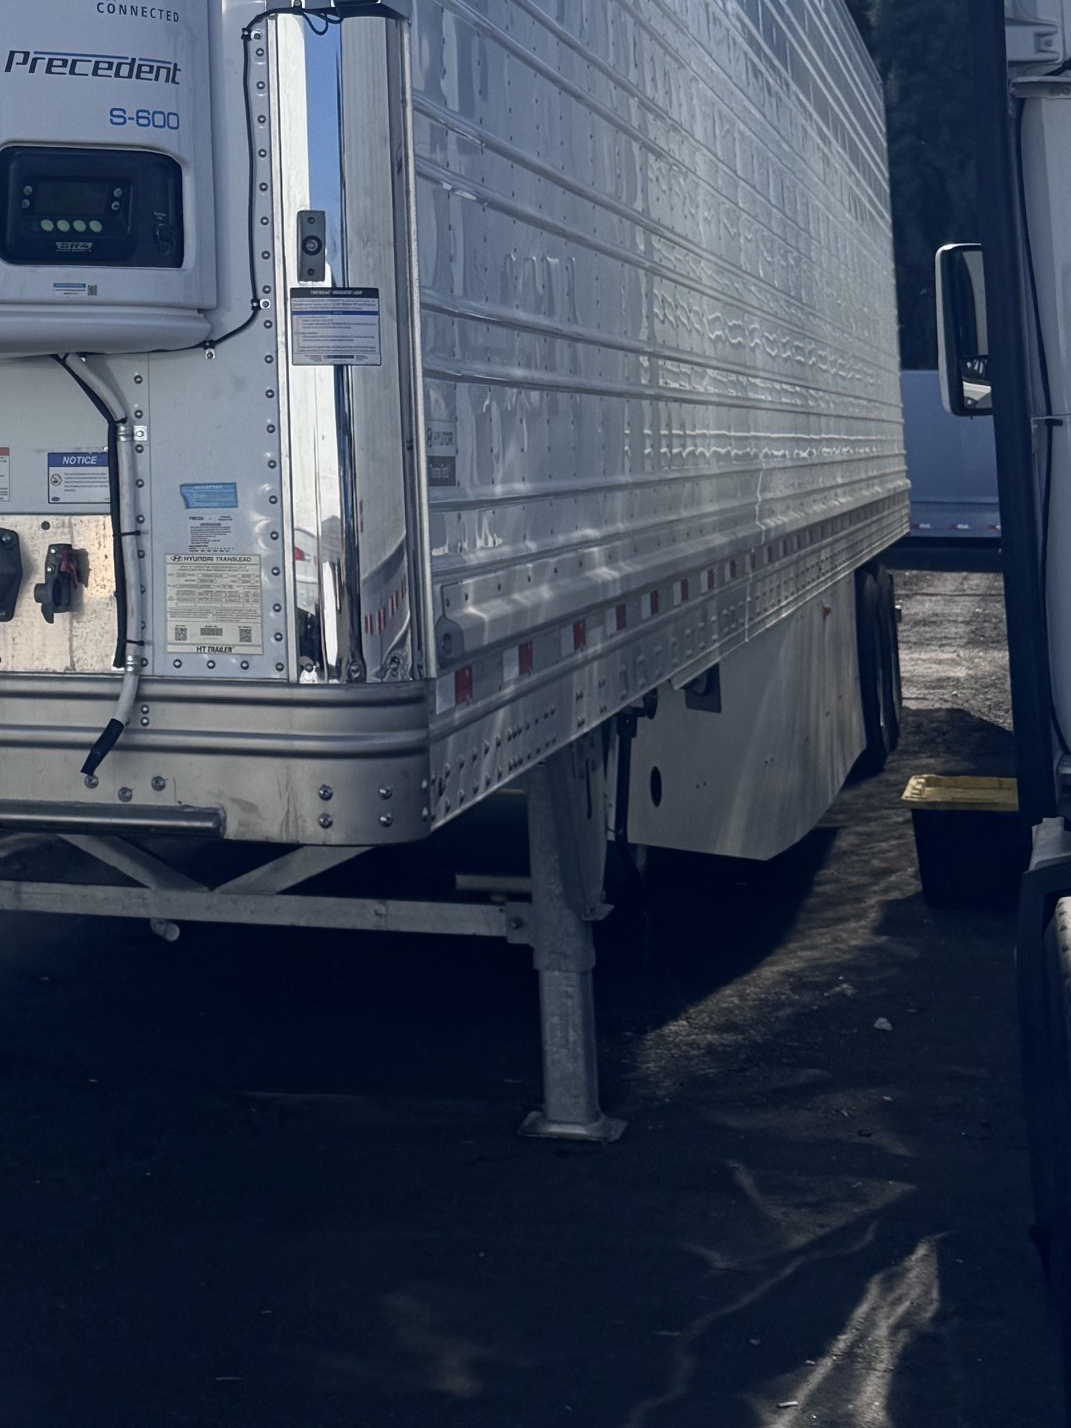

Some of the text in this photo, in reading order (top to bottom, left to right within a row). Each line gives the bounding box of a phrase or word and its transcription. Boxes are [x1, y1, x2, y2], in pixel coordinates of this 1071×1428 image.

[96, 1, 180, 24] CONNECTED
[4, 49, 182, 85] Precedent
[108, 107, 180, 131] S-600
[62, 456, 98, 465] NOTICE
